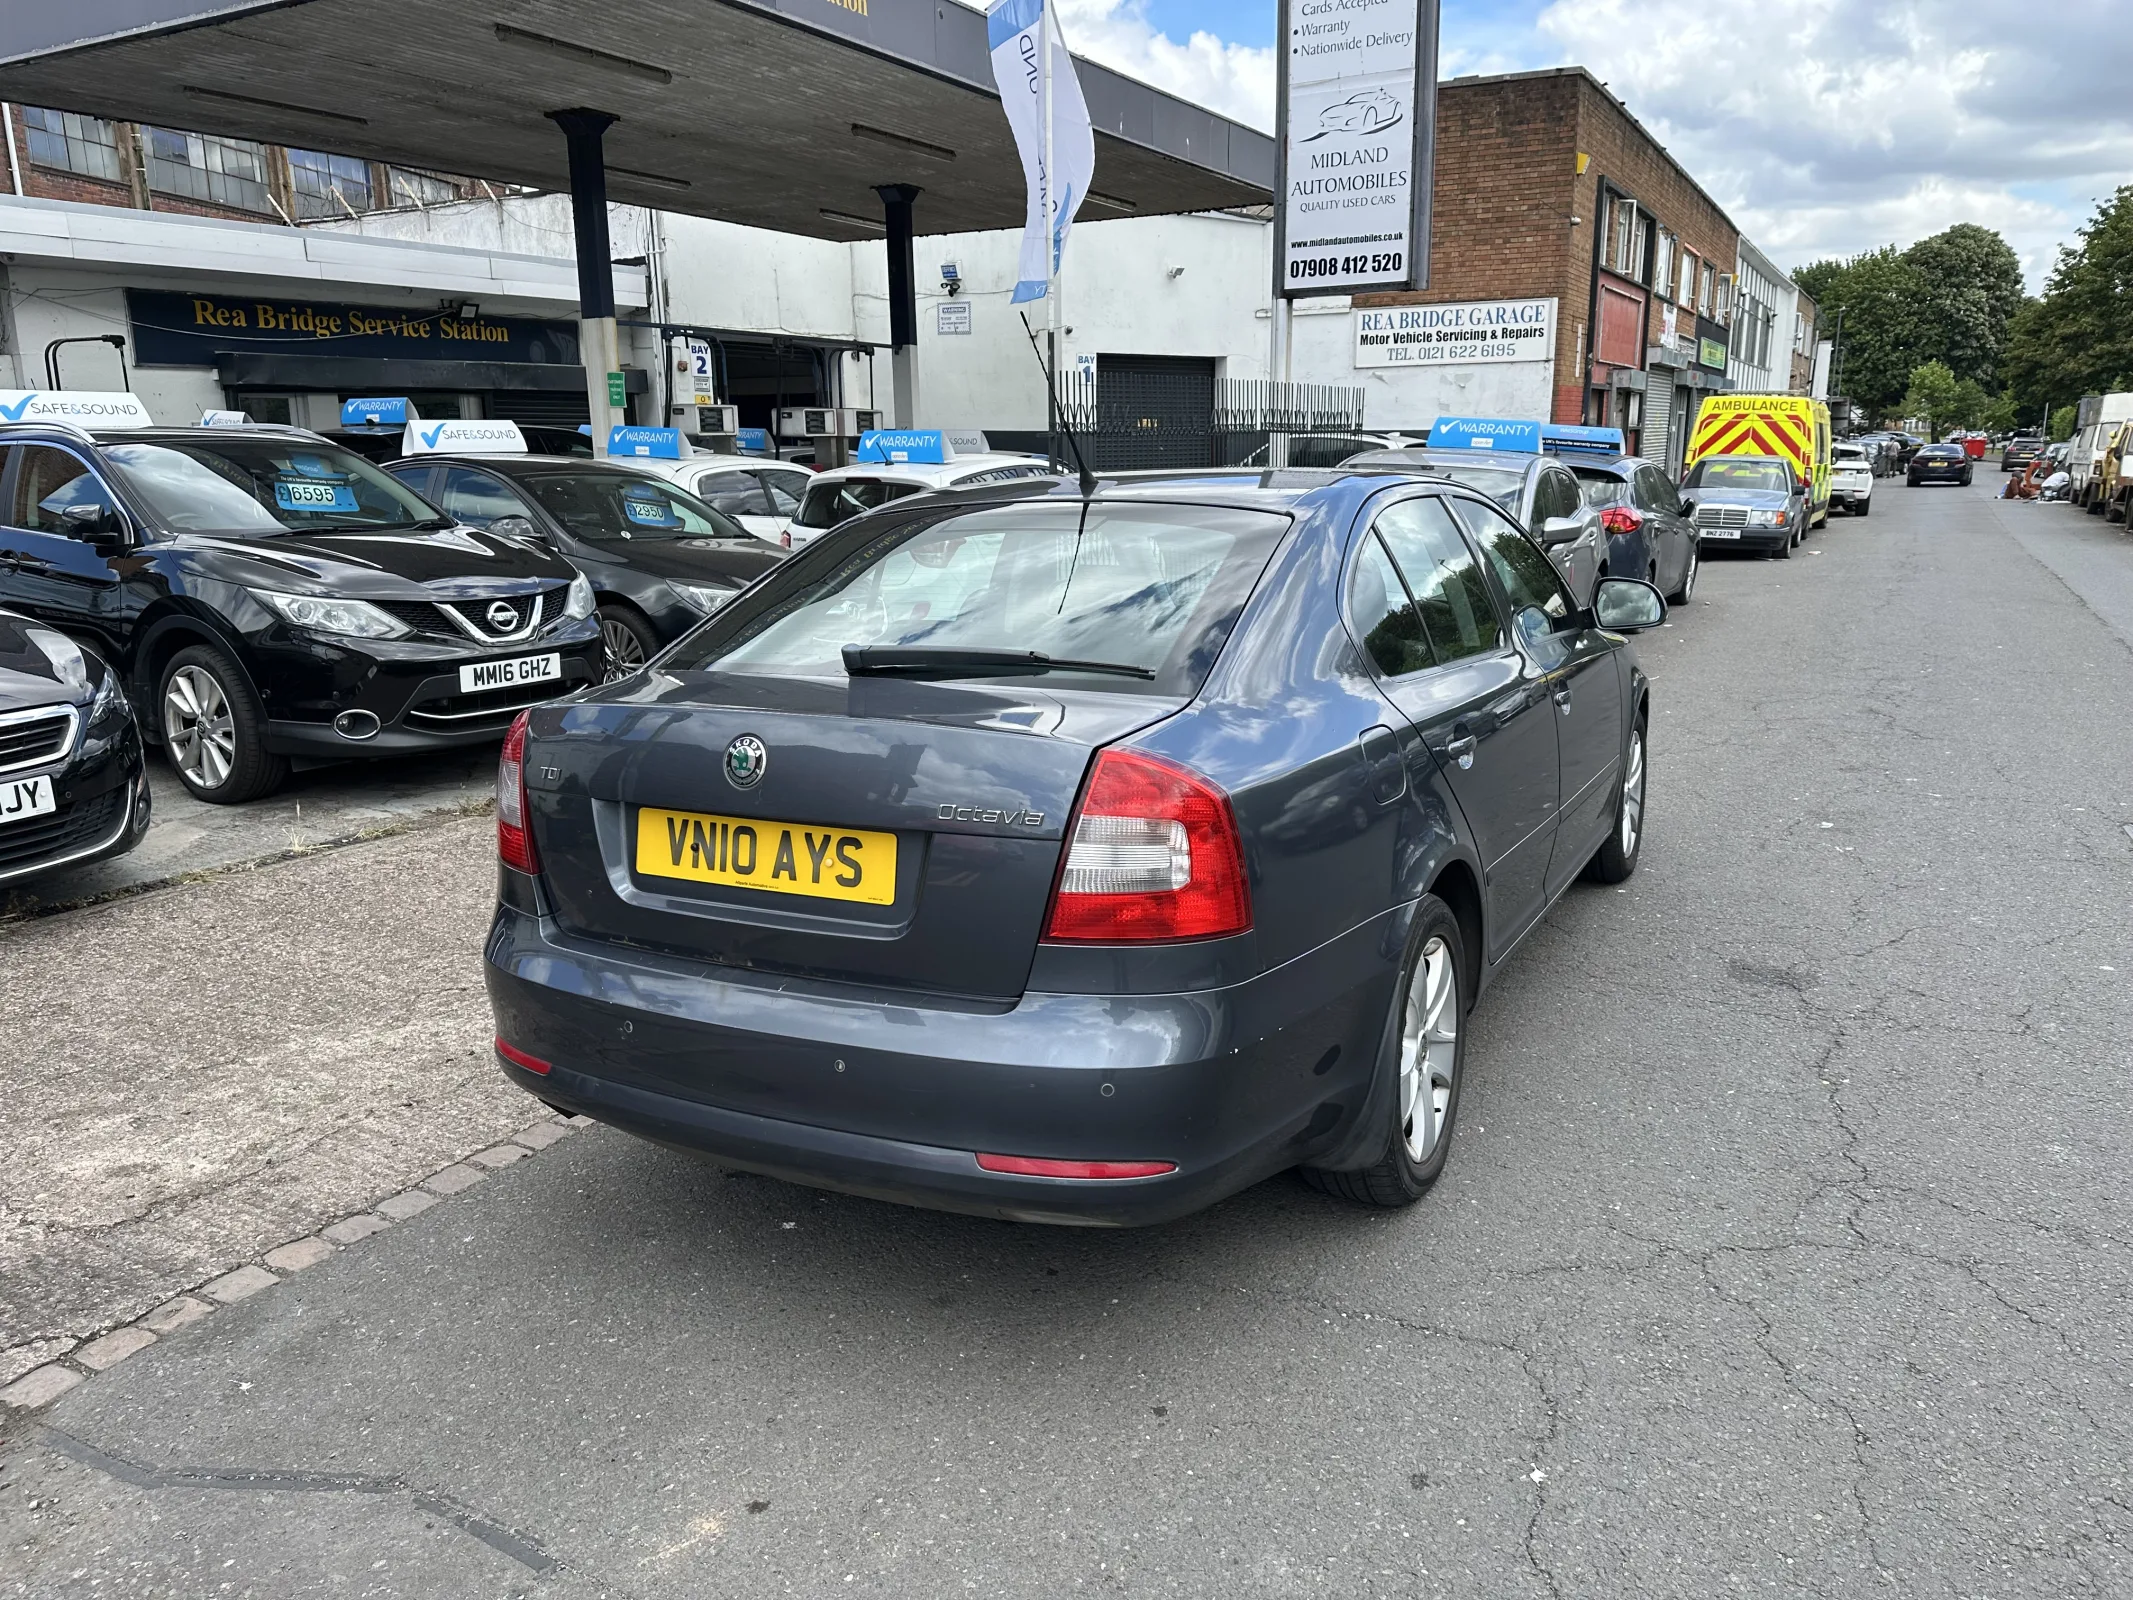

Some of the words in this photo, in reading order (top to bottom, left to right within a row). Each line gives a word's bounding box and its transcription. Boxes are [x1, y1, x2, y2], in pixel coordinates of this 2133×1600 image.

[1302, 0, 1332, 16] Cards
[1302, 20, 1350, 36] Warranty
[1301, 36, 1362, 56] Nationwide
[1366, 32, 1413, 48] Delivery
[1311, 146, 1388, 169] MIDLAND
[1291, 170, 1407, 196] AUTOMOBILES
[1300, 199, 1340, 213] QUALITY
[1342, 197, 1368, 208] USED
[1370, 194, 1396, 206] CARS
[1291, 232, 1403, 248] www.midlandautomobiles.co.uk
[1290, 258, 1338, 278] 07908
[1341, 255, 1368, 274] 412
[1372, 252, 1402, 272] 520
[192, 300, 247, 327] Rea
[256, 304, 342, 338] Bridge
[349, 311, 430, 338] Service
[438, 317, 509, 342] Station
[1361, 313, 1394, 331] REA
[1400, 308, 1465, 329] BRIDGE
[1469, 304, 1545, 326] GARAGE
[1360, 333, 1390, 346] Motor
[1393, 330, 1432, 344] Vehicle
[1436, 328, 1487, 342] Servicing
[1490, 330, 1498, 340] &
[1501, 326, 1544, 340] Repairs
[691, 345, 709, 354] BAY
[1387, 348, 1414, 360] TEL.
[1418, 346, 1444, 360] 0121
[1449, 345, 1477, 358] 622
[1481, 343, 1516, 357] 6195
[696, 356, 707, 374] 2
[1078, 355, 1095, 364] BAY
[1083, 366, 1091, 382] 1
[30, 402, 138, 416] SAFE&SOUND
[358, 401, 402, 411] WARRANTY
[1712, 400, 1798, 412] AMBULANCE
[442, 430, 516, 440] SAFE&SOUND
[626, 432, 674, 444] WARRANTY
[1459, 423, 1533, 436] WARRANTY
[880, 436, 937, 447] WARRANTY
[473, 663, 514, 686] MM16
[519, 657, 551, 679] GHZ
[0, 781, 38, 815] JY
[938, 803, 1045, 826] Octavia
[666, 817, 757, 876] VN10
[771, 830, 863, 888] AYS
